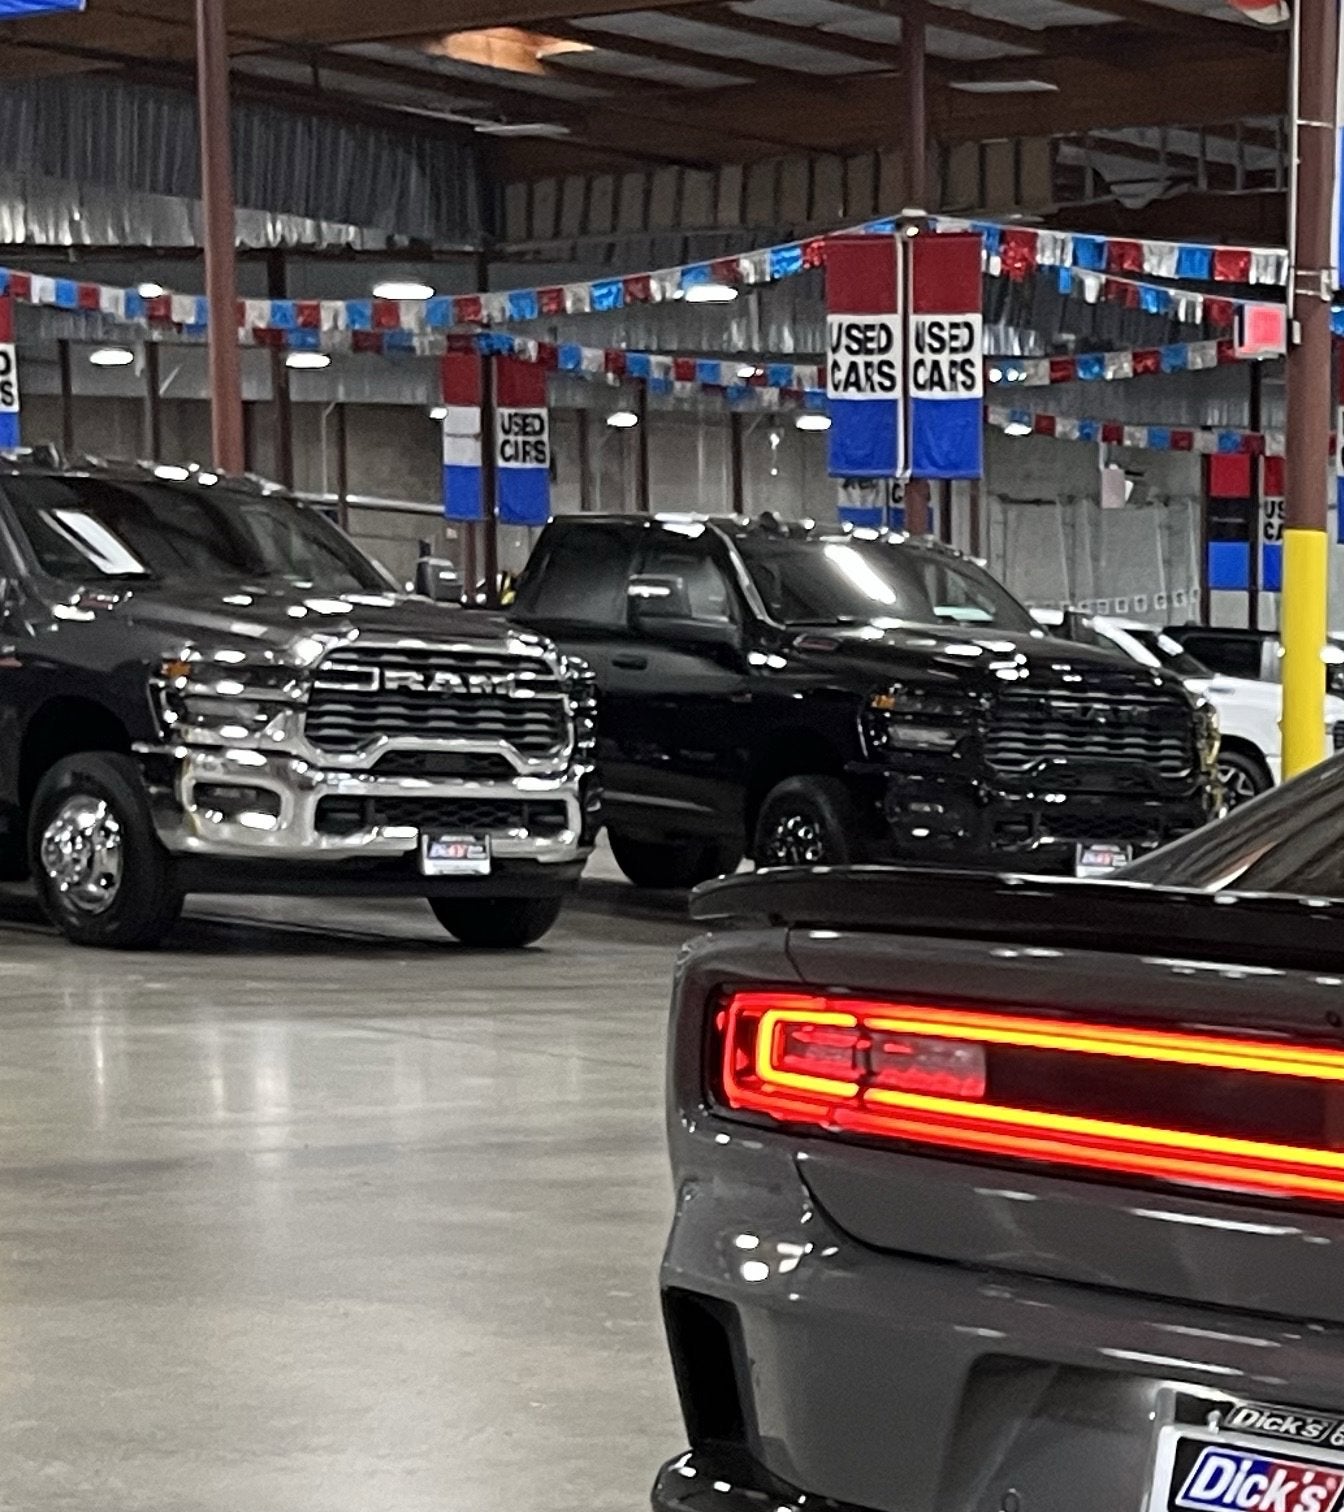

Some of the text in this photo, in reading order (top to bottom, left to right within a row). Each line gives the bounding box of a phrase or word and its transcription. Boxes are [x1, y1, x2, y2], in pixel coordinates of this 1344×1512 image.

[831, 322, 894, 355] USED
[915, 321, 975, 354] USED
[831, 359, 896, 392] CARS
[913, 358, 976, 391] CARS
[501, 413, 545, 436] USED
[383, 669, 510, 695] RAM
[1232, 1407, 1328, 1440] Dick's
